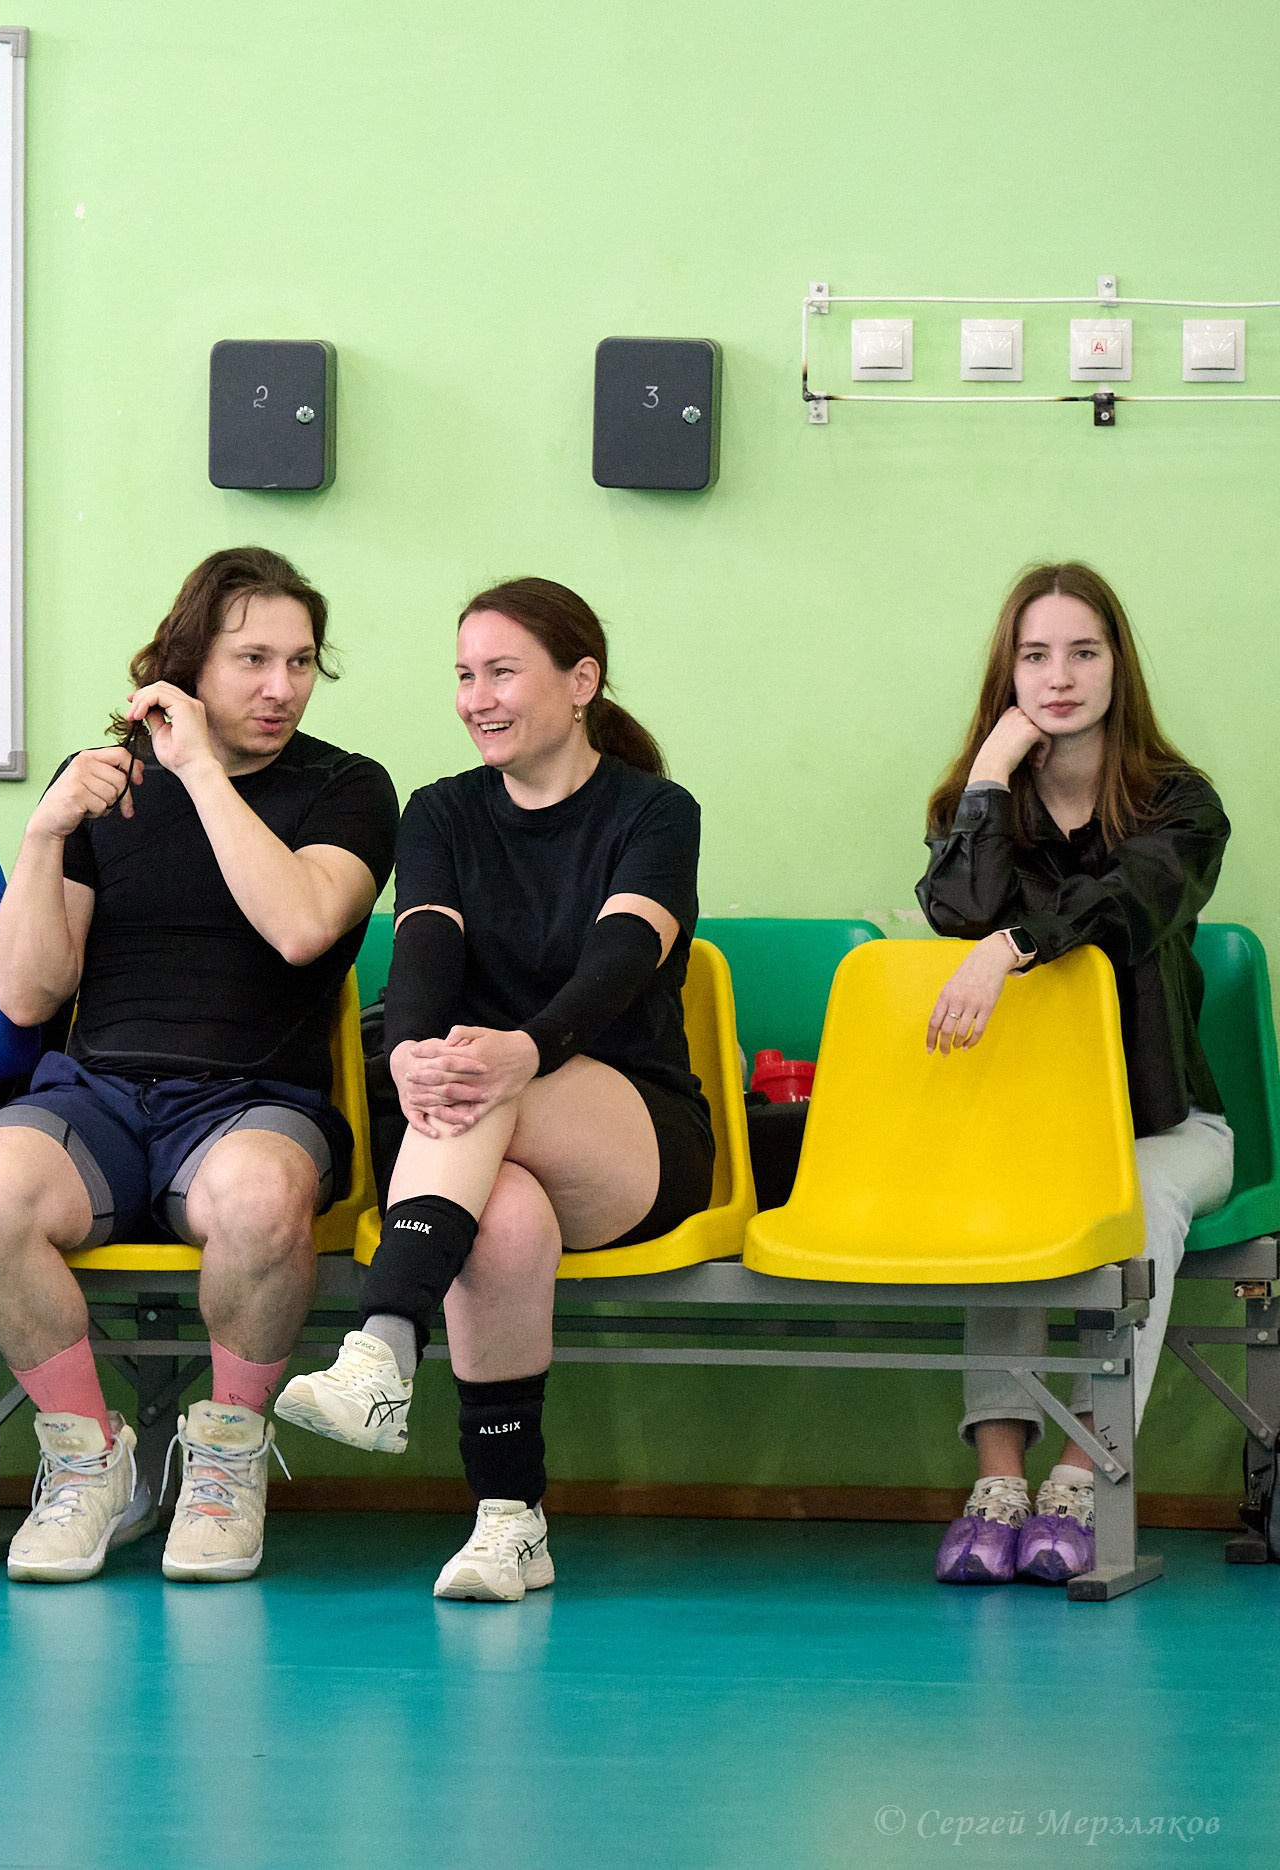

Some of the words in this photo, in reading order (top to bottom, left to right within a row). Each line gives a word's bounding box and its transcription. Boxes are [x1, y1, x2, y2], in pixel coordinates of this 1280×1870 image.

[252, 385, 269, 409] 2
[642, 385, 660, 409] 3
[393, 1219, 433, 1235] ALLSIX
[479, 1420, 521, 1435] ALLSIX
